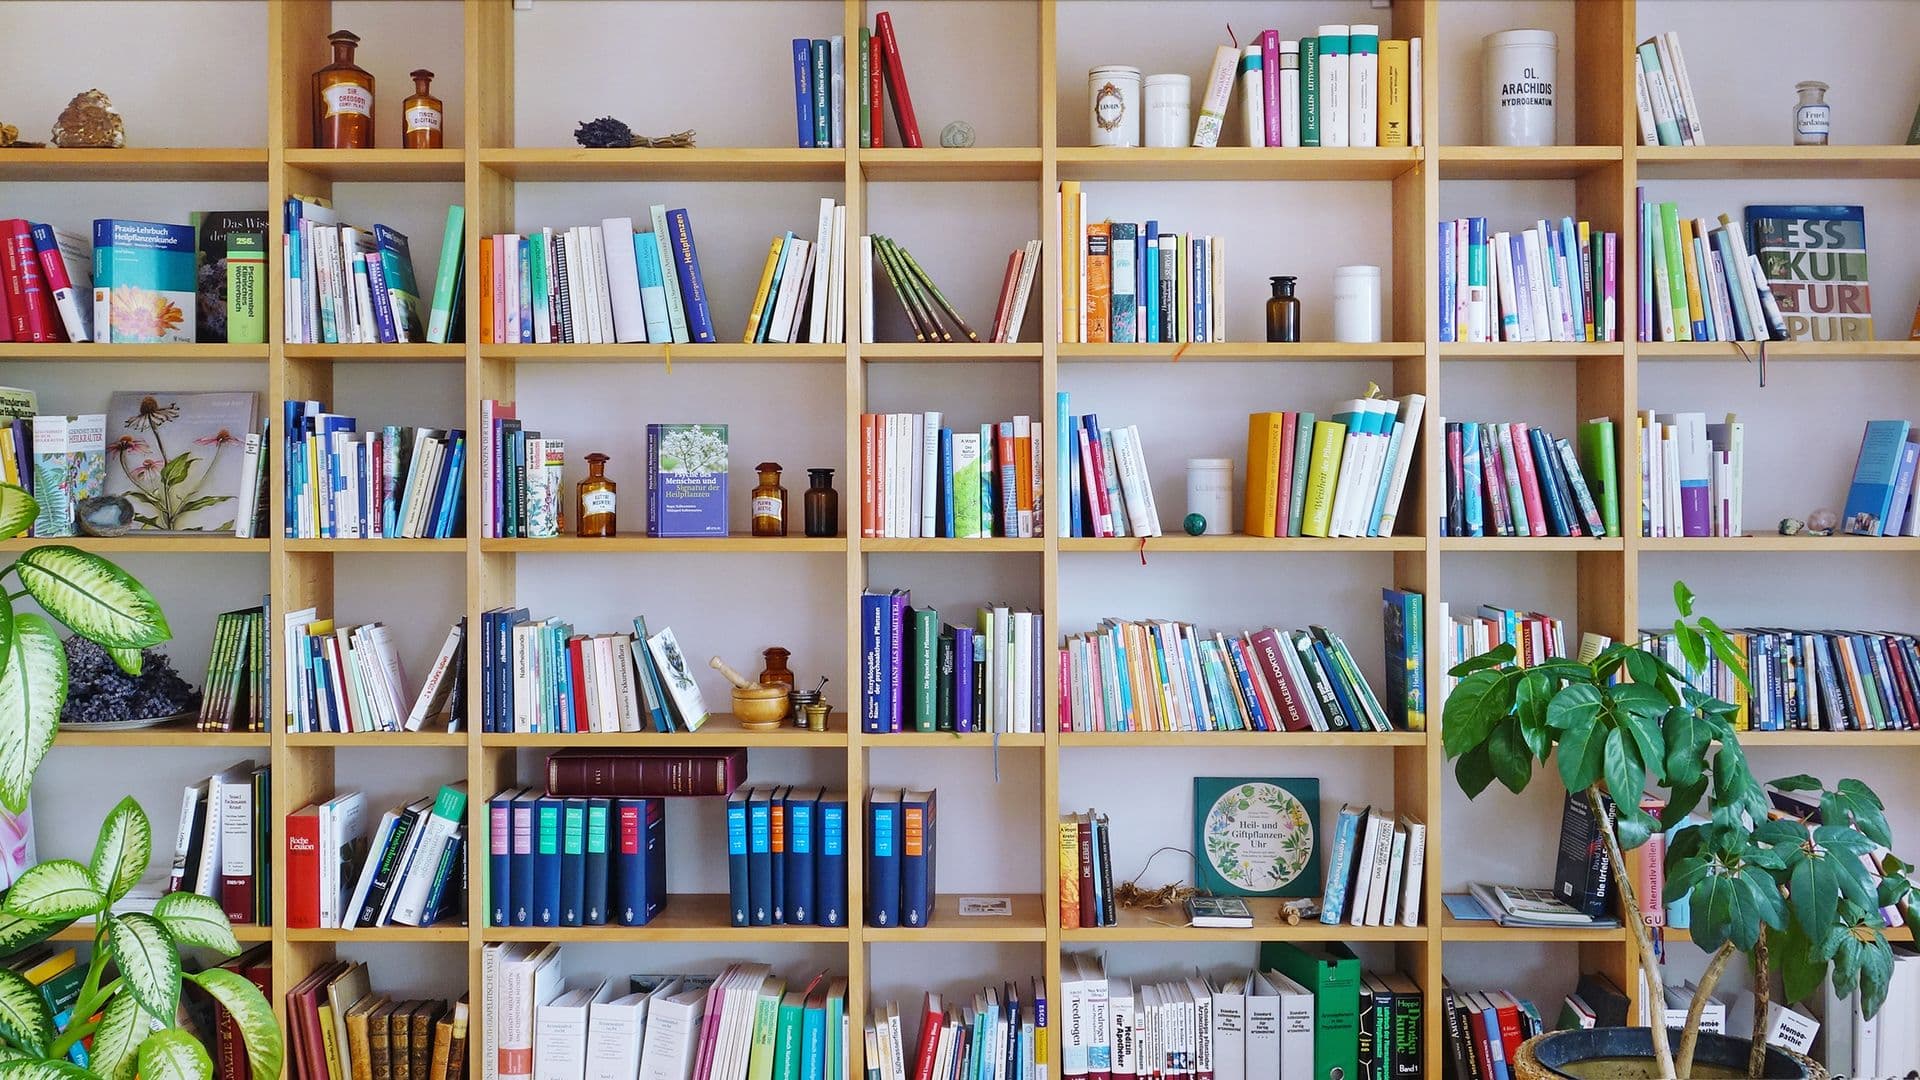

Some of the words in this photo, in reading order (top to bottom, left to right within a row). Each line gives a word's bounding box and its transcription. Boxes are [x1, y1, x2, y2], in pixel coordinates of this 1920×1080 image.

[1524, 68, 1539, 79] OL.
[1502, 83, 1552, 95] ARACHIDIS
[115, 225, 168, 235] Praxis-Lehrbuch
[223, 218, 242, 229] Das
[1787, 220, 1845, 249] ESS
[115, 233, 177, 245] Heilpflanzenkunde
[676, 214, 693, 263] Heilpflanzen
[1788, 251, 1857, 281] KUL
[1785, 284, 1860, 313] TUR
[1788, 316, 1857, 341] PUR
[665, 490, 710, 499] Heilpflanzen
[676, 484, 706, 492] Signatur
[1314, 472, 1327, 510] Weisheit
[618, 644, 629, 694] Exkursionsflora
[874, 636, 882, 682] psychoaktiven
[1265, 647, 1283, 678] DOKTOR
[868, 652, 876, 695] Enzyklopädie
[1277, 679, 1292, 705] KLEINE
[1836, 688, 1845, 710] WATER
[1288, 705, 1300, 721] DER
[1232, 830, 1286, 841] Giftpflanzen-
[1240, 820, 1259, 830] Heil-
[1262, 820, 1278, 830] und
[290, 837, 309, 845] Roche
[1250, 840, 1267, 849] Uhr
[1649, 843, 1657, 868] heilen
[1597, 884, 1606, 897] Die
[1649, 870, 1658, 910] Alternativ
[486, 950, 494, 972] WELT
[1398, 1000, 1419, 1008] Hoppe
[1071, 998, 1081, 1046] Teedrogen
[1096, 1004, 1105, 1043] Teedrogen
[1116, 1014, 1124, 1027] für
[1408, 1009, 1420, 1055] Drogen
[1124, 1026, 1132, 1055] Medizin
[1396, 1014, 1409, 1054] kunde
[1778, 1032, 1802, 1046] pathie
[1116, 1028, 1124, 1067] Apotheker
[1400, 1064, 1414, 1072] Band
[1467, 1046, 1477, 1075] Intelligenz
